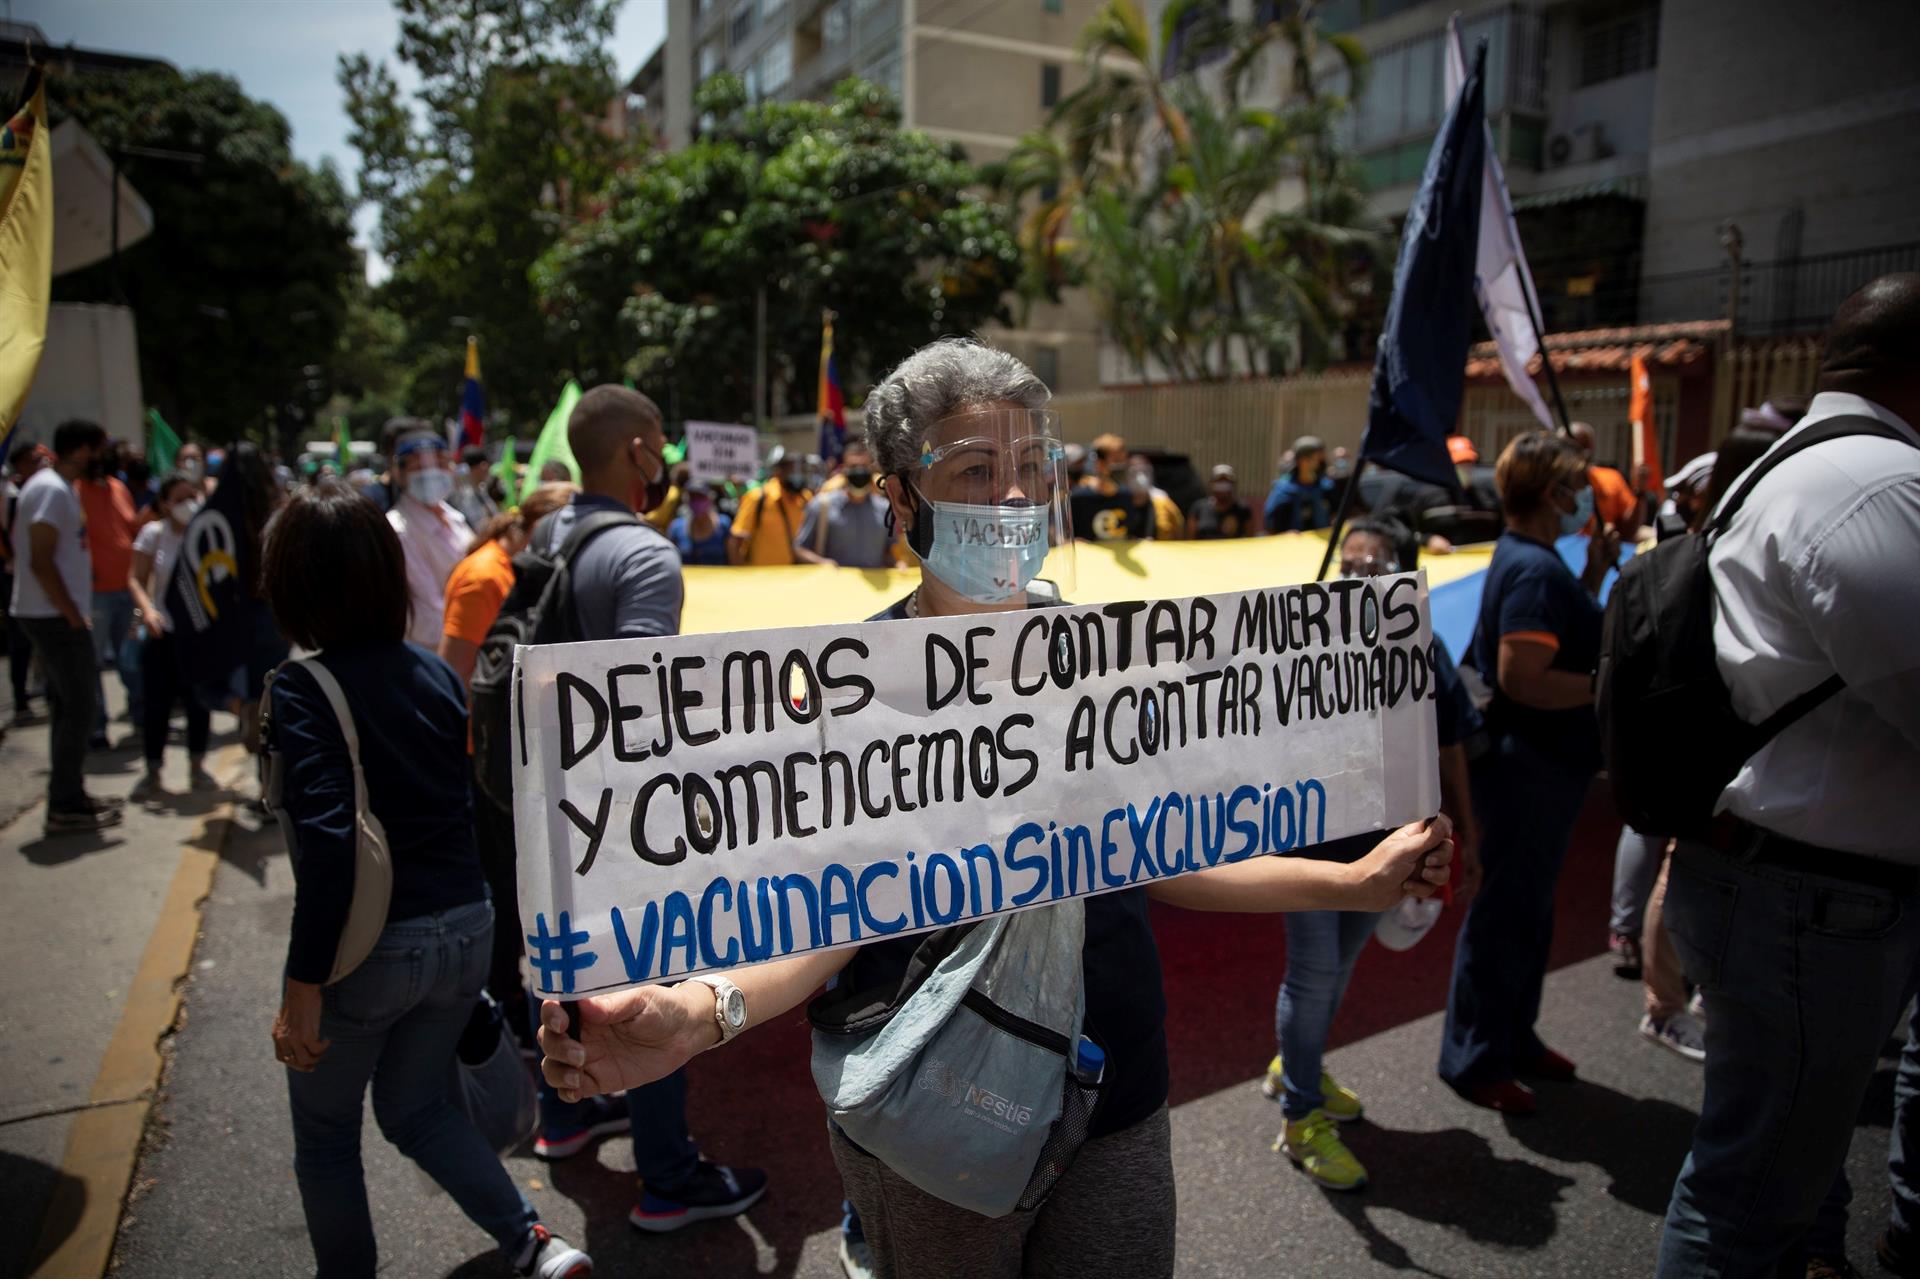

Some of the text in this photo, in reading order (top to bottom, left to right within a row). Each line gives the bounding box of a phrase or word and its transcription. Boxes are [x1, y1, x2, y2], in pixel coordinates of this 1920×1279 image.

[925, 626, 997, 711] DE
[1011, 596, 1218, 696] CONTAR
[1231, 577, 1420, 656] MUERTOS
[558, 787, 613, 876] Y
[630, 712, 1039, 866] COMENCEMOS
